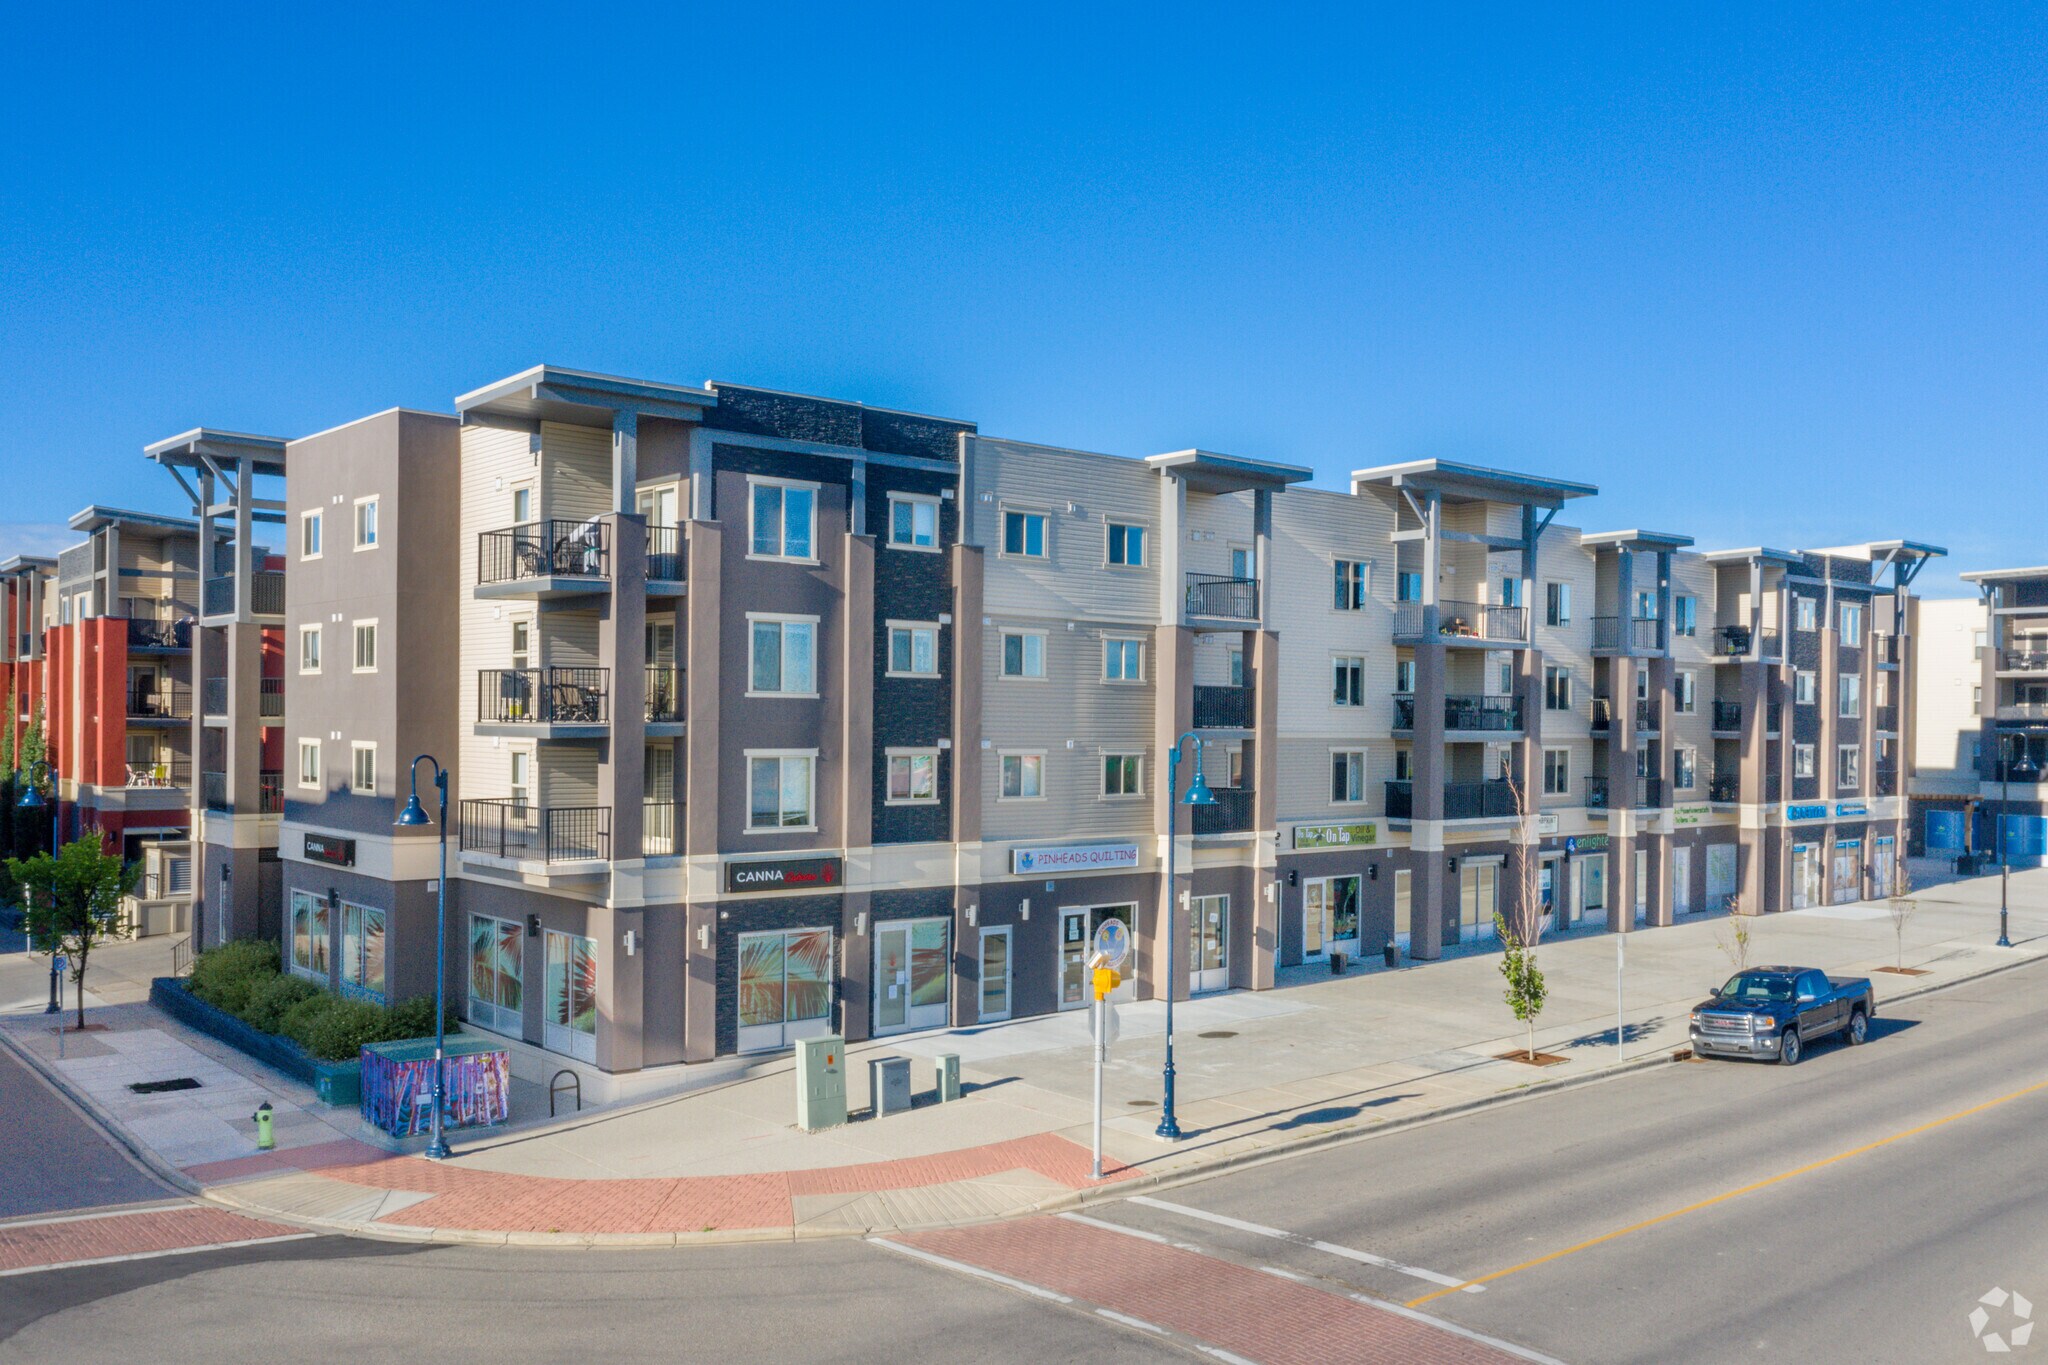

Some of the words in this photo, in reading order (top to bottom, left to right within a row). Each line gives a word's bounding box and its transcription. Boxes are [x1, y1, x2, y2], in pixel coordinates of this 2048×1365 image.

[1326, 828, 1336, 843] On
[1338, 826, 1350, 844] Tap
[306, 841, 324, 852] CANNA
[1038, 852, 1088, 865] PINHEADS
[1090, 849, 1136, 863] QUILTING
[736, 870, 784, 883] CANNA
